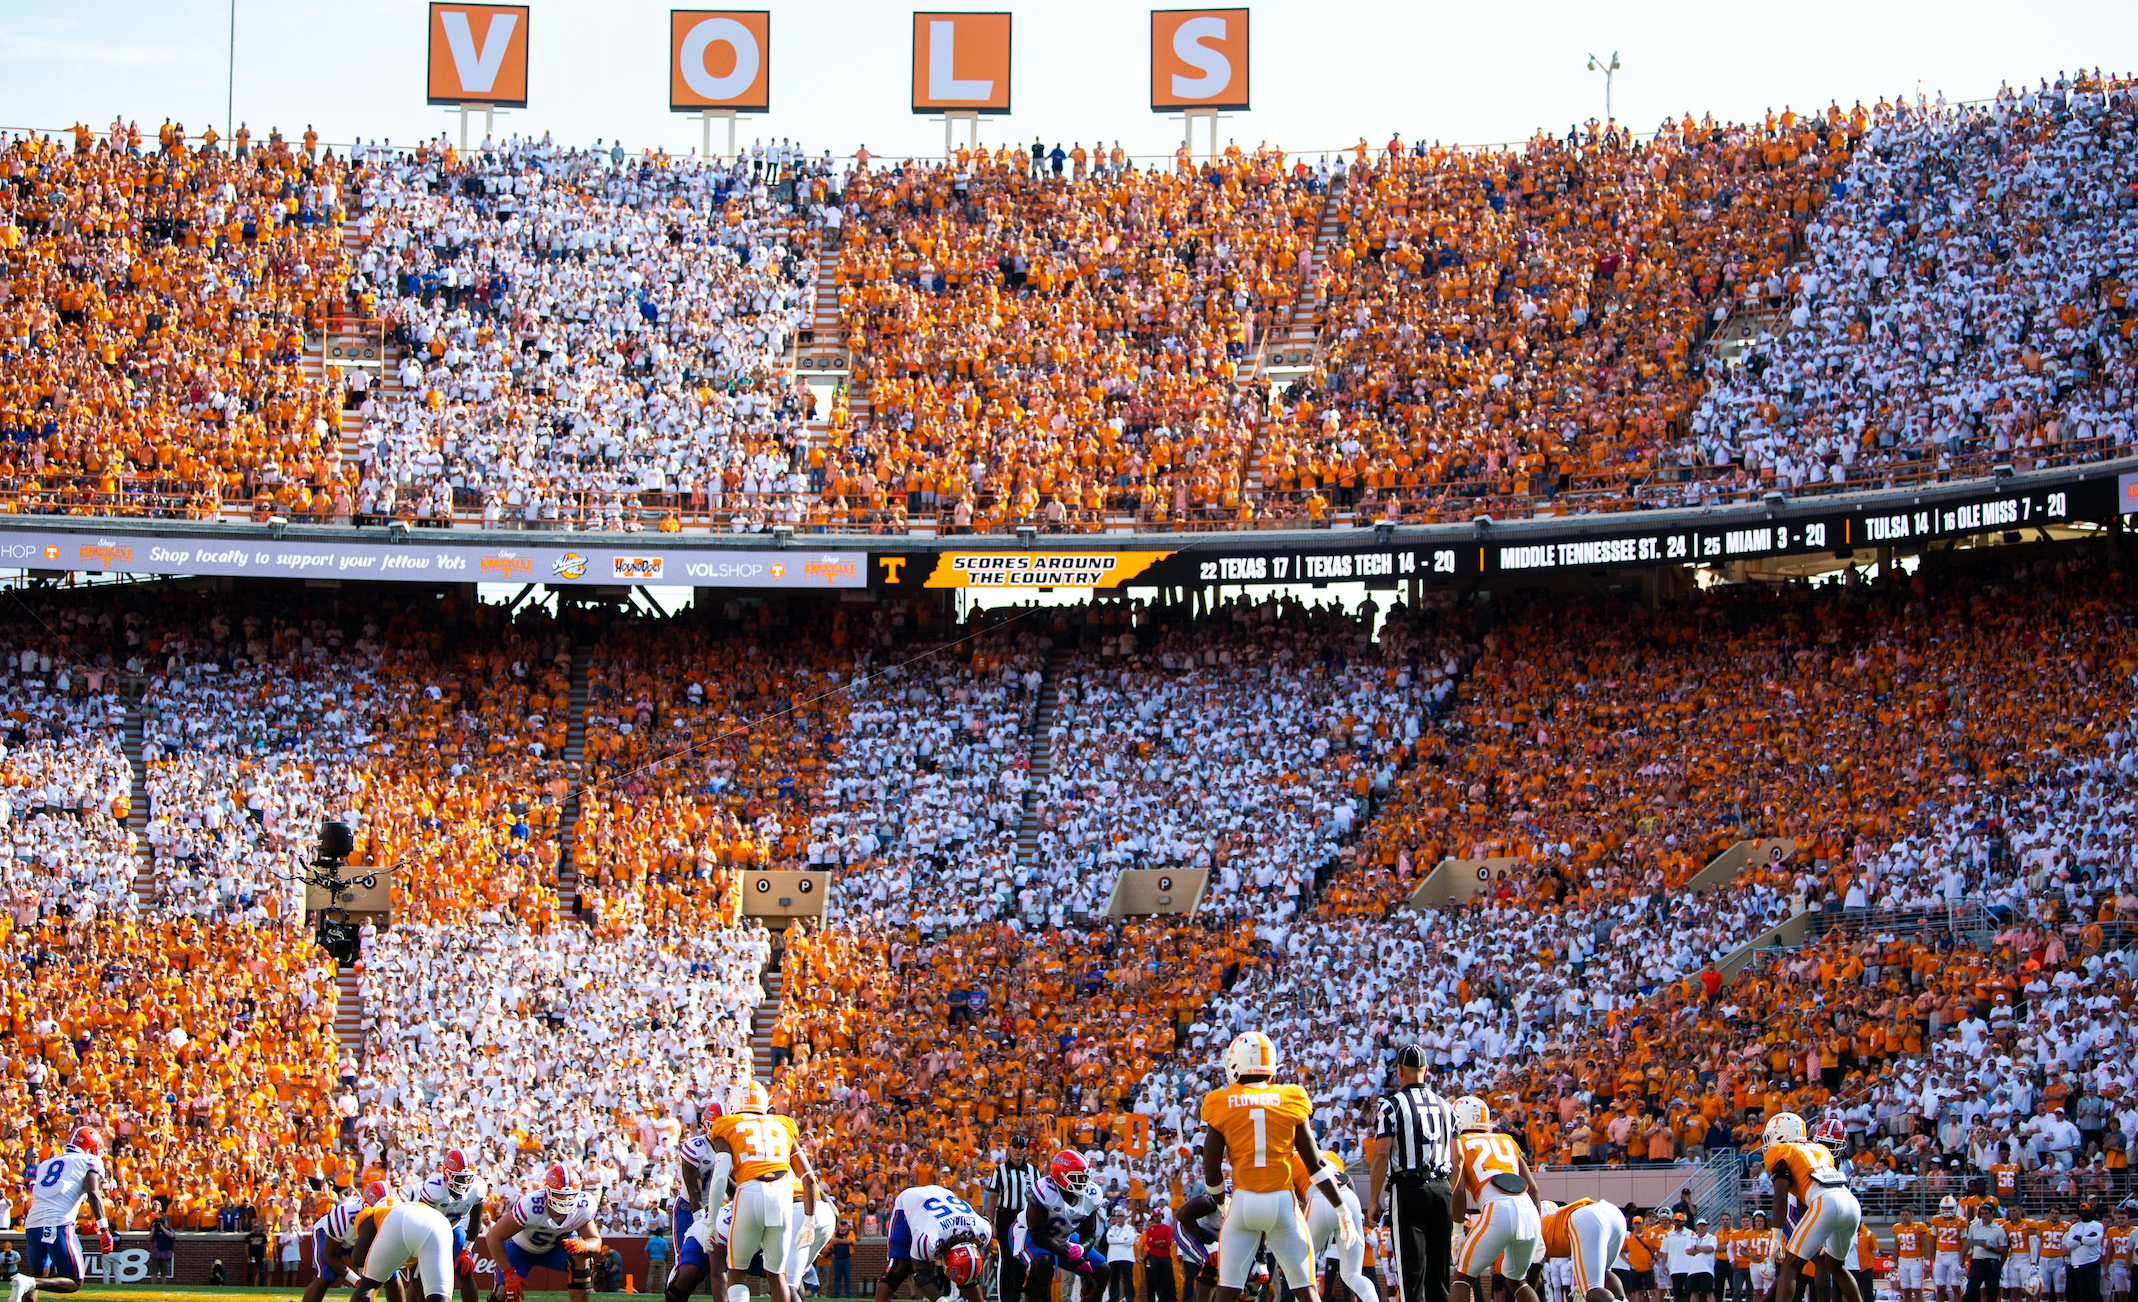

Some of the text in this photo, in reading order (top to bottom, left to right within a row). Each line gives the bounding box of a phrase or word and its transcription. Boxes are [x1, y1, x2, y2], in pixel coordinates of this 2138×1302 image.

[439, 11, 1233, 101] V O L S
[1865, 513, 1910, 541] TULSA
[1913, 508, 1930, 535] 14
[1943, 512, 1956, 532] 16
[1957, 505, 1981, 530] OLE
[1982, 499, 2018, 527] MISS
[2022, 497, 2031, 521] 7
[2047, 491, 2067, 518] 2Q
[97, 537, 117, 548] Shop
[1500, 543, 1556, 570] MIDDLE
[1556, 538, 1636, 567] TENNESSEE
[1638, 537, 1661, 561] ST.
[1666, 535, 1687, 559] 24
[1703, 536, 1721, 556] 25
[1725, 527, 1772, 555] MIAMI
[1777, 526, 1788, 549] 3
[1805, 522, 1826, 547] 2Q
[79, 545, 134, 561] KNOXVILLE
[149, 546, 467, 571] Shop locally to support your fellow Vols
[480, 558, 533, 570] KNOXVILLE
[804, 562, 856, 575] KNOXVILLE
[879, 557, 906, 584] T
[953, 556, 1116, 570] SCORES AROUND
[1200, 562, 1218, 580] 22
[1219, 557, 1267, 580] TEXAS
[1272, 556, 1289, 578] 17
[1305, 555, 1352, 578] TEXAS
[1354, 552, 1393, 576] TECH
[1398, 552, 1416, 574] 14
[1433, 549, 1456, 574] 2Q
[968, 571, 1102, 585] THE COUNTRY
[1478, 868, 1489, 880] Q
[758, 880, 769, 892] O
[801, 881, 810, 892] P
[1161, 878, 1170, 890] P
[1227, 1092, 1281, 1109] FLOWERS
[1771, 1116, 1786, 1129] T
[1249, 1107, 1267, 1168] 1
[1464, 1137, 1520, 1183] 24
[40, 1159, 65, 1188] 8
[531, 1196, 545, 1215] 58
[1897, 1233, 1917, 1251] 39
[1938, 1227, 1958, 1244] 22
[2008, 1232, 2025, 1249] 31
[2042, 1231, 2064, 1250] 35
[1751, 1237, 1770, 1255] 47
[119, 1248, 150, 1282] 8
